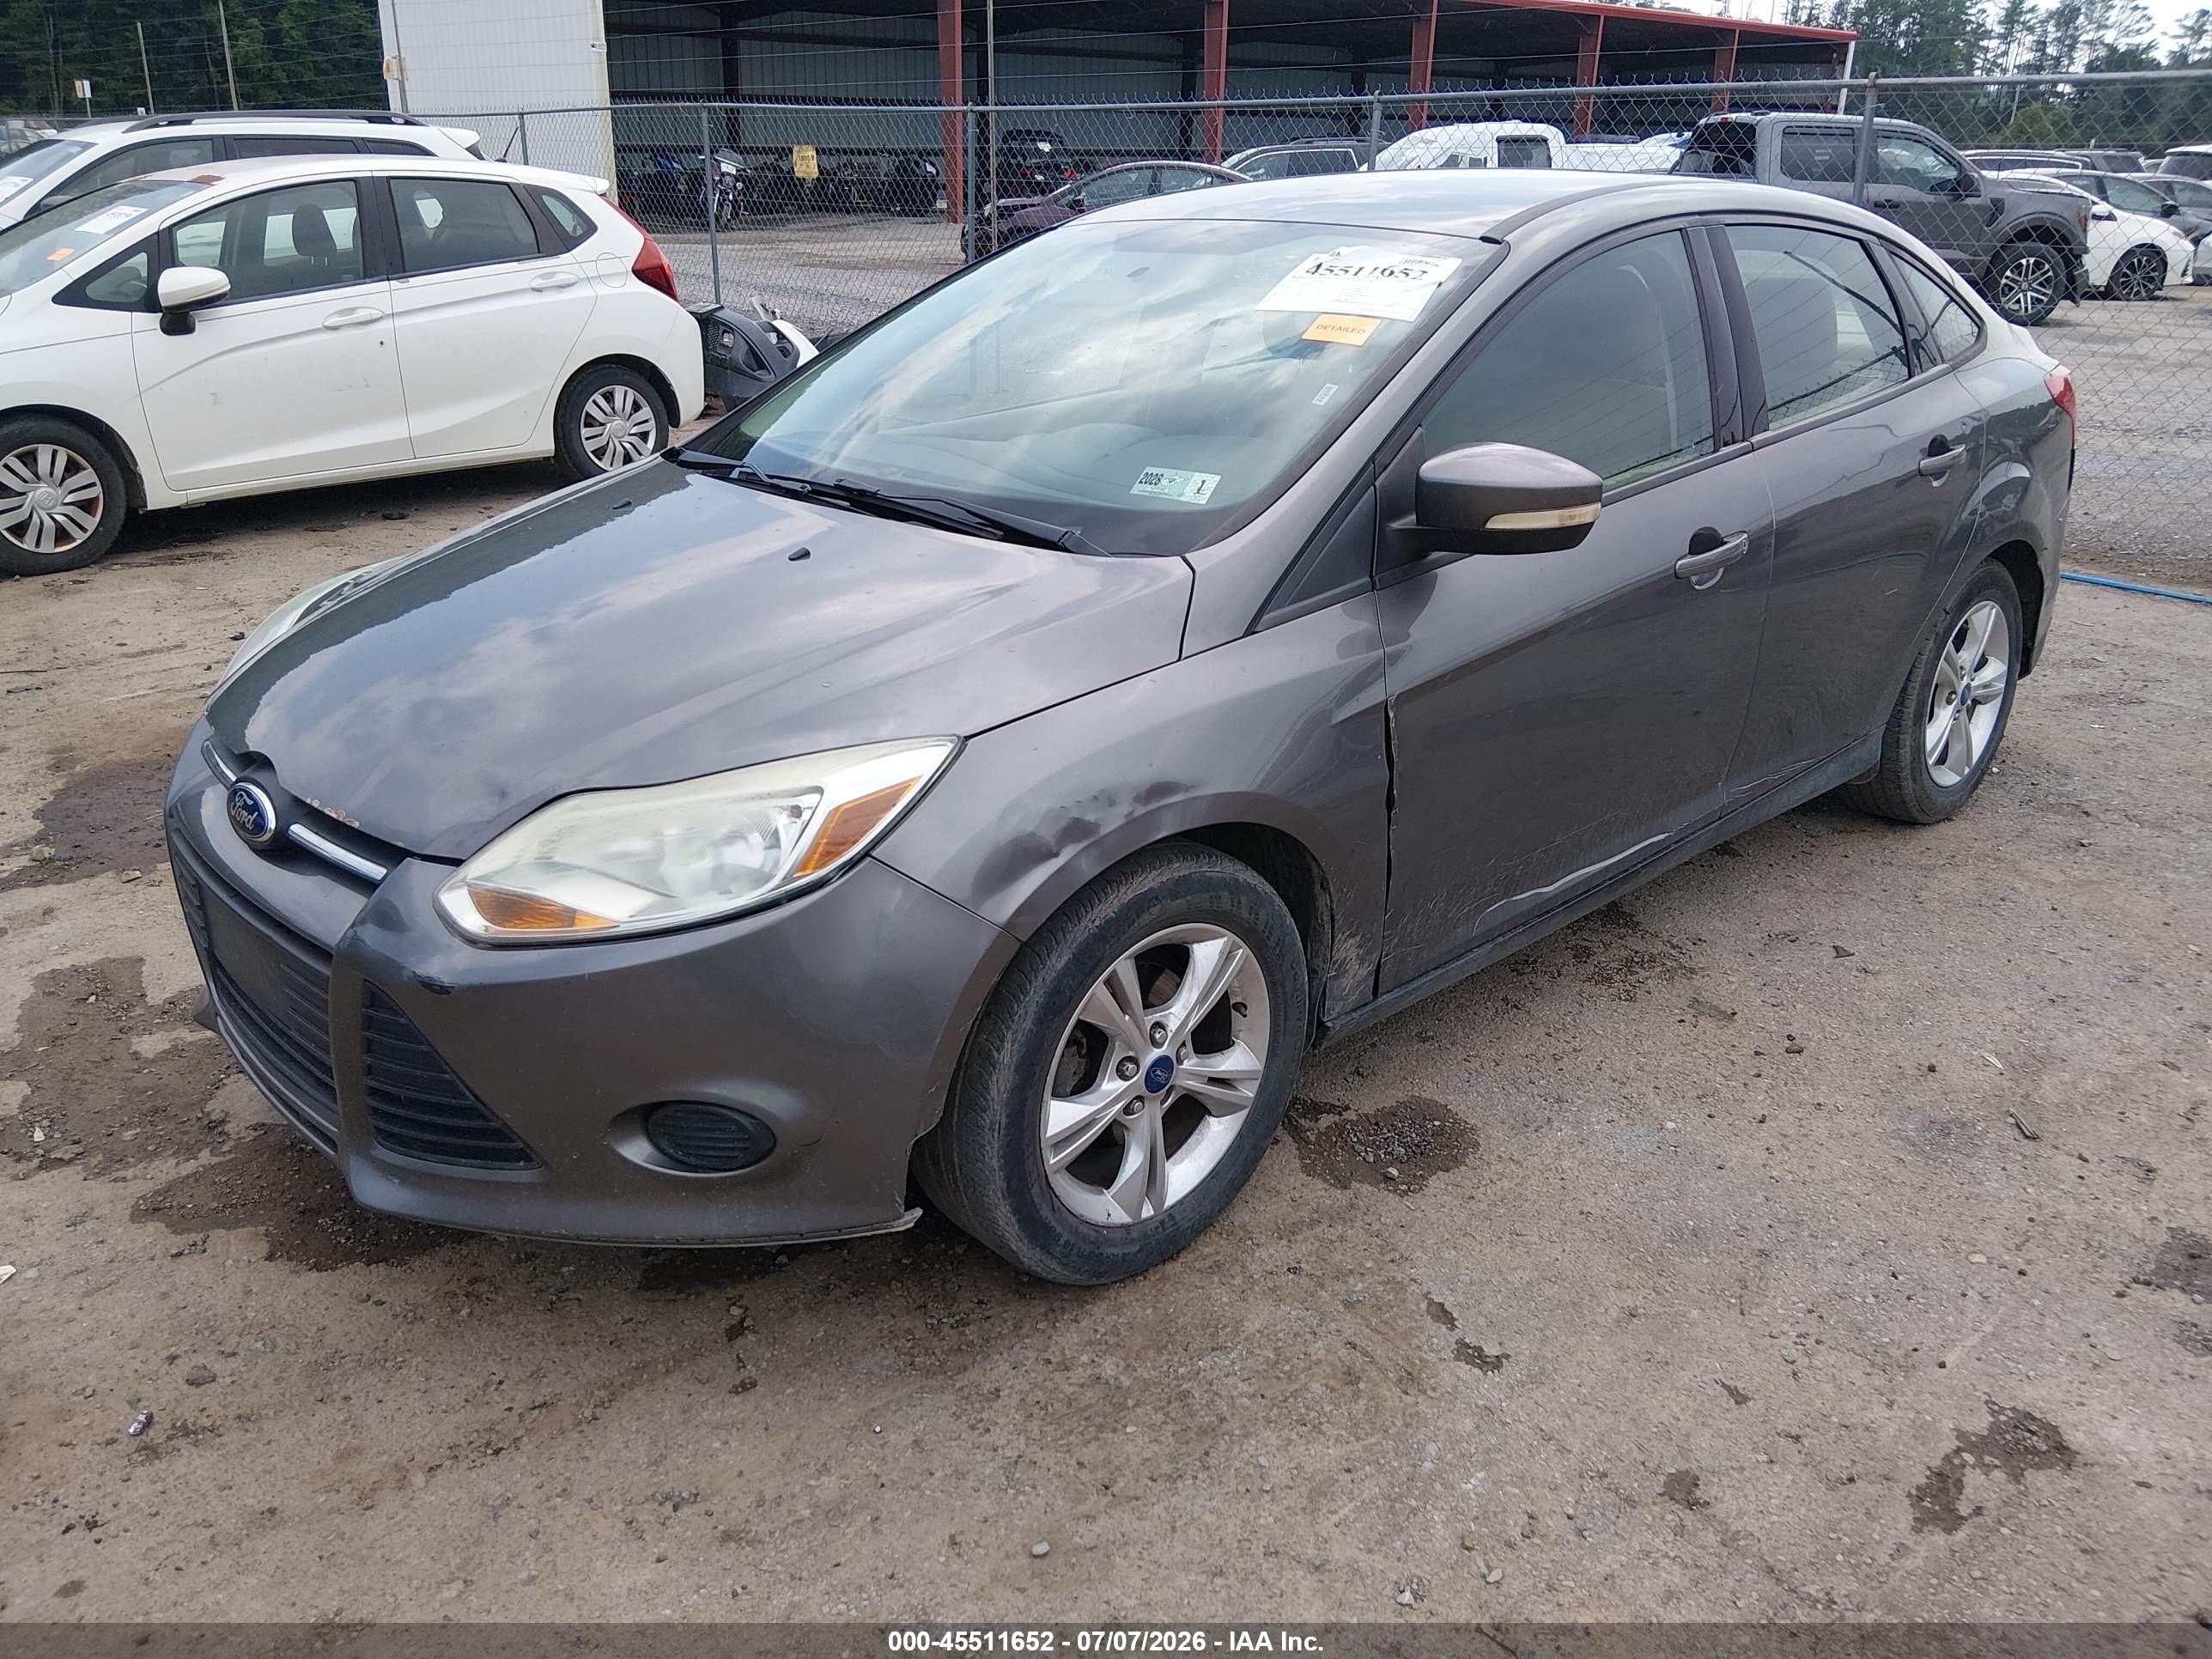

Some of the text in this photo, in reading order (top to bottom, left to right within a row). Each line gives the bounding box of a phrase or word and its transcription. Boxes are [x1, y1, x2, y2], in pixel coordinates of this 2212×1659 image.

[1305, 261, 1428, 281] 45511652
[1316, 324, 1365, 334] DETAILED
[1138, 471, 1164, 486] 2028
[1193, 479, 1206, 495] 1
[231, 791, 258, 830] Ford
